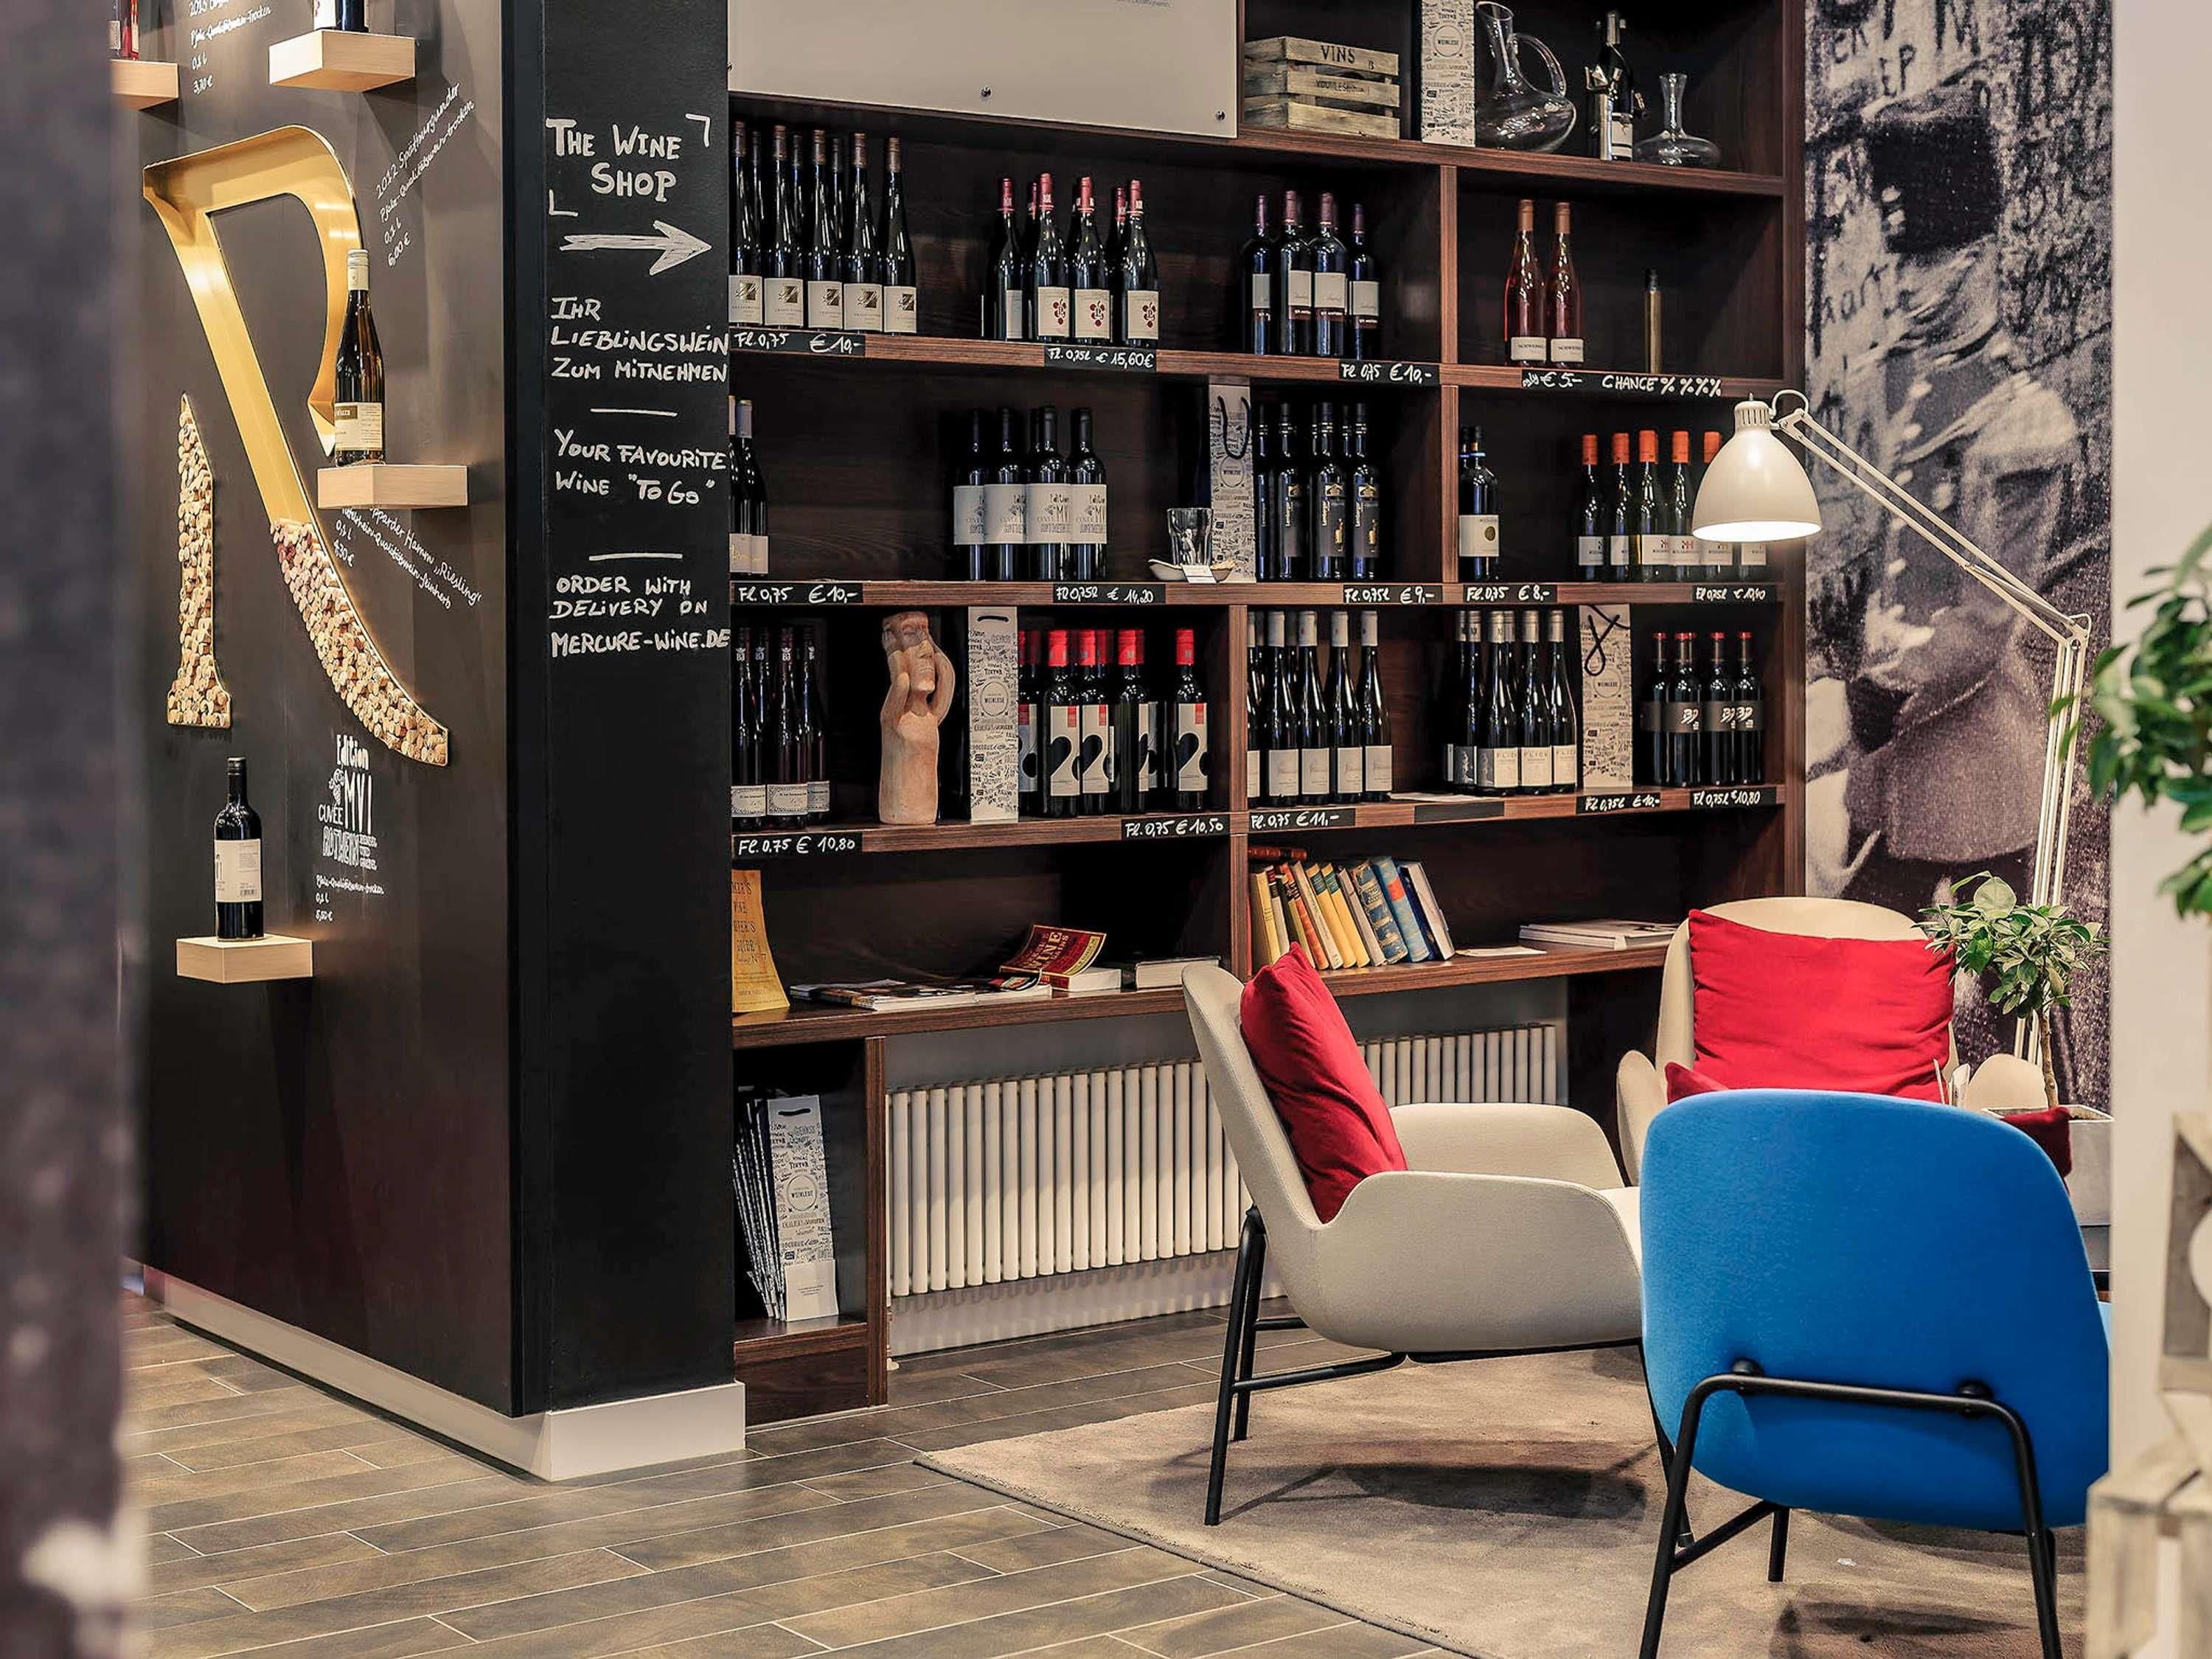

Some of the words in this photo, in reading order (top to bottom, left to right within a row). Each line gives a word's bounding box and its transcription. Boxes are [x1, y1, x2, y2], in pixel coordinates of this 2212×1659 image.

[1321, 45, 1355, 64] VINS
[546, 117, 596, 157] THE
[612, 123, 683, 161] WINE
[375, 164, 399, 199] 2012
[591, 161, 677, 204] SHOP
[551, 296, 602, 321] IHR
[550, 325, 729, 356] LIEBLINGSWEIN
[552, 357, 601, 380] ZUM
[614, 358, 728, 383] MITNEHMEN
[1601, 375, 1658, 392] CHANCE
[554, 428, 611, 462] YOUR
[617, 445, 728, 470] FAVOURITE
[556, 470, 611, 495] WINE
[556, 574, 630, 594] ORDER
[645, 578, 692, 596] WITH
[549, 598, 663, 619] DELIVERY
[680, 599, 708, 615] ON
[552, 629, 731, 658] MERCURE-WINE.DE
[336, 734, 369, 771] Edition
